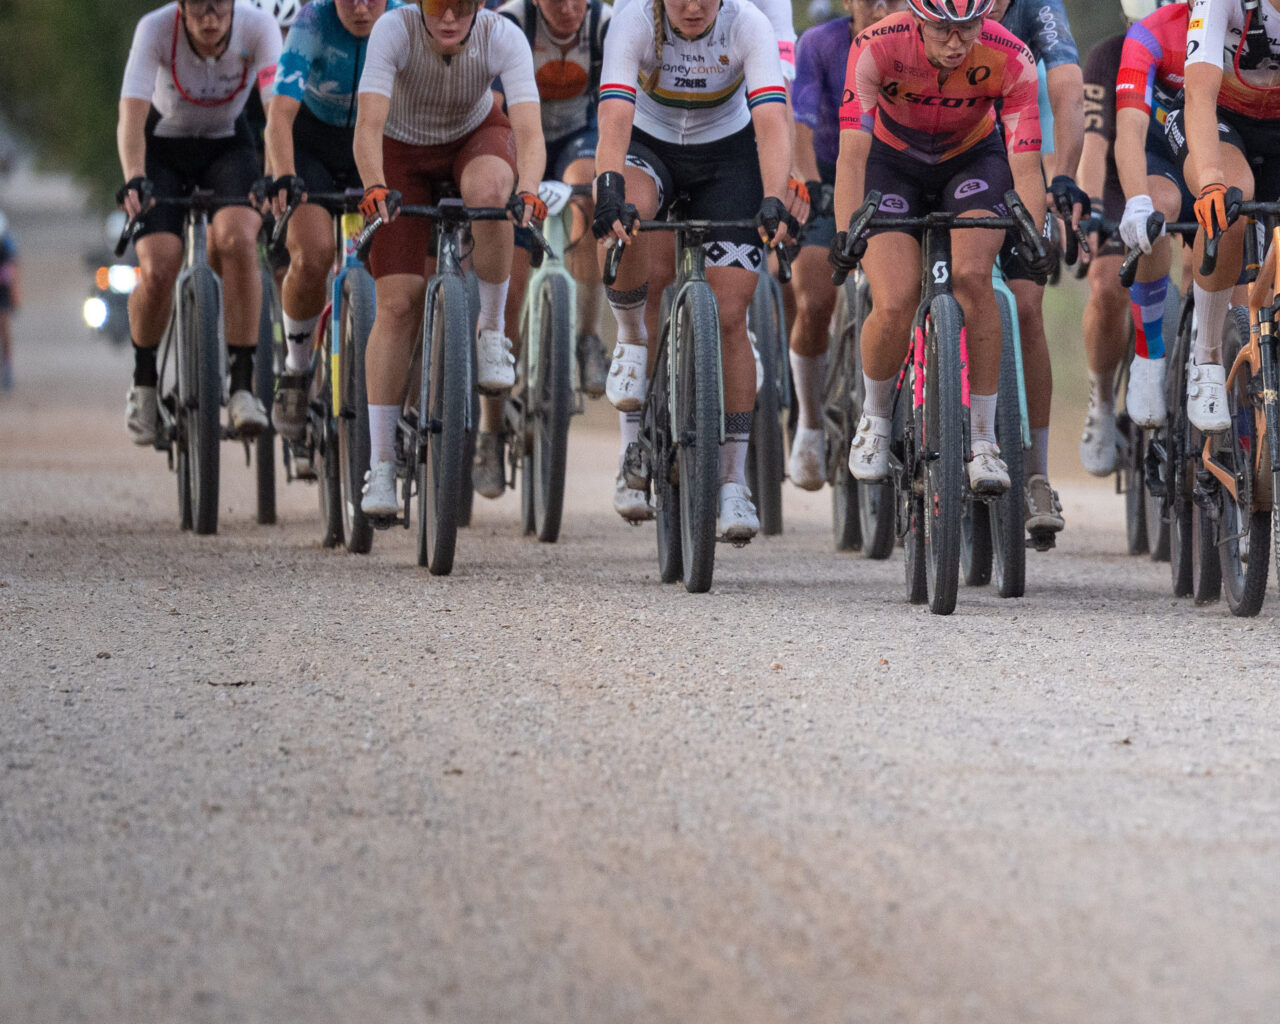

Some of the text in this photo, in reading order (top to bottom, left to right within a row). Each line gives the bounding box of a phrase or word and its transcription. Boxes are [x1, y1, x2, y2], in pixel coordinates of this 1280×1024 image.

[871, 24, 911, 37] KENDA
[981, 31, 1034, 64] SHIMANO
[680, 54, 705, 63] TEAM
[662, 63, 726, 76] oneycomb
[674, 77, 707, 88] 226ERS
[904, 91, 990, 108] SCOT
